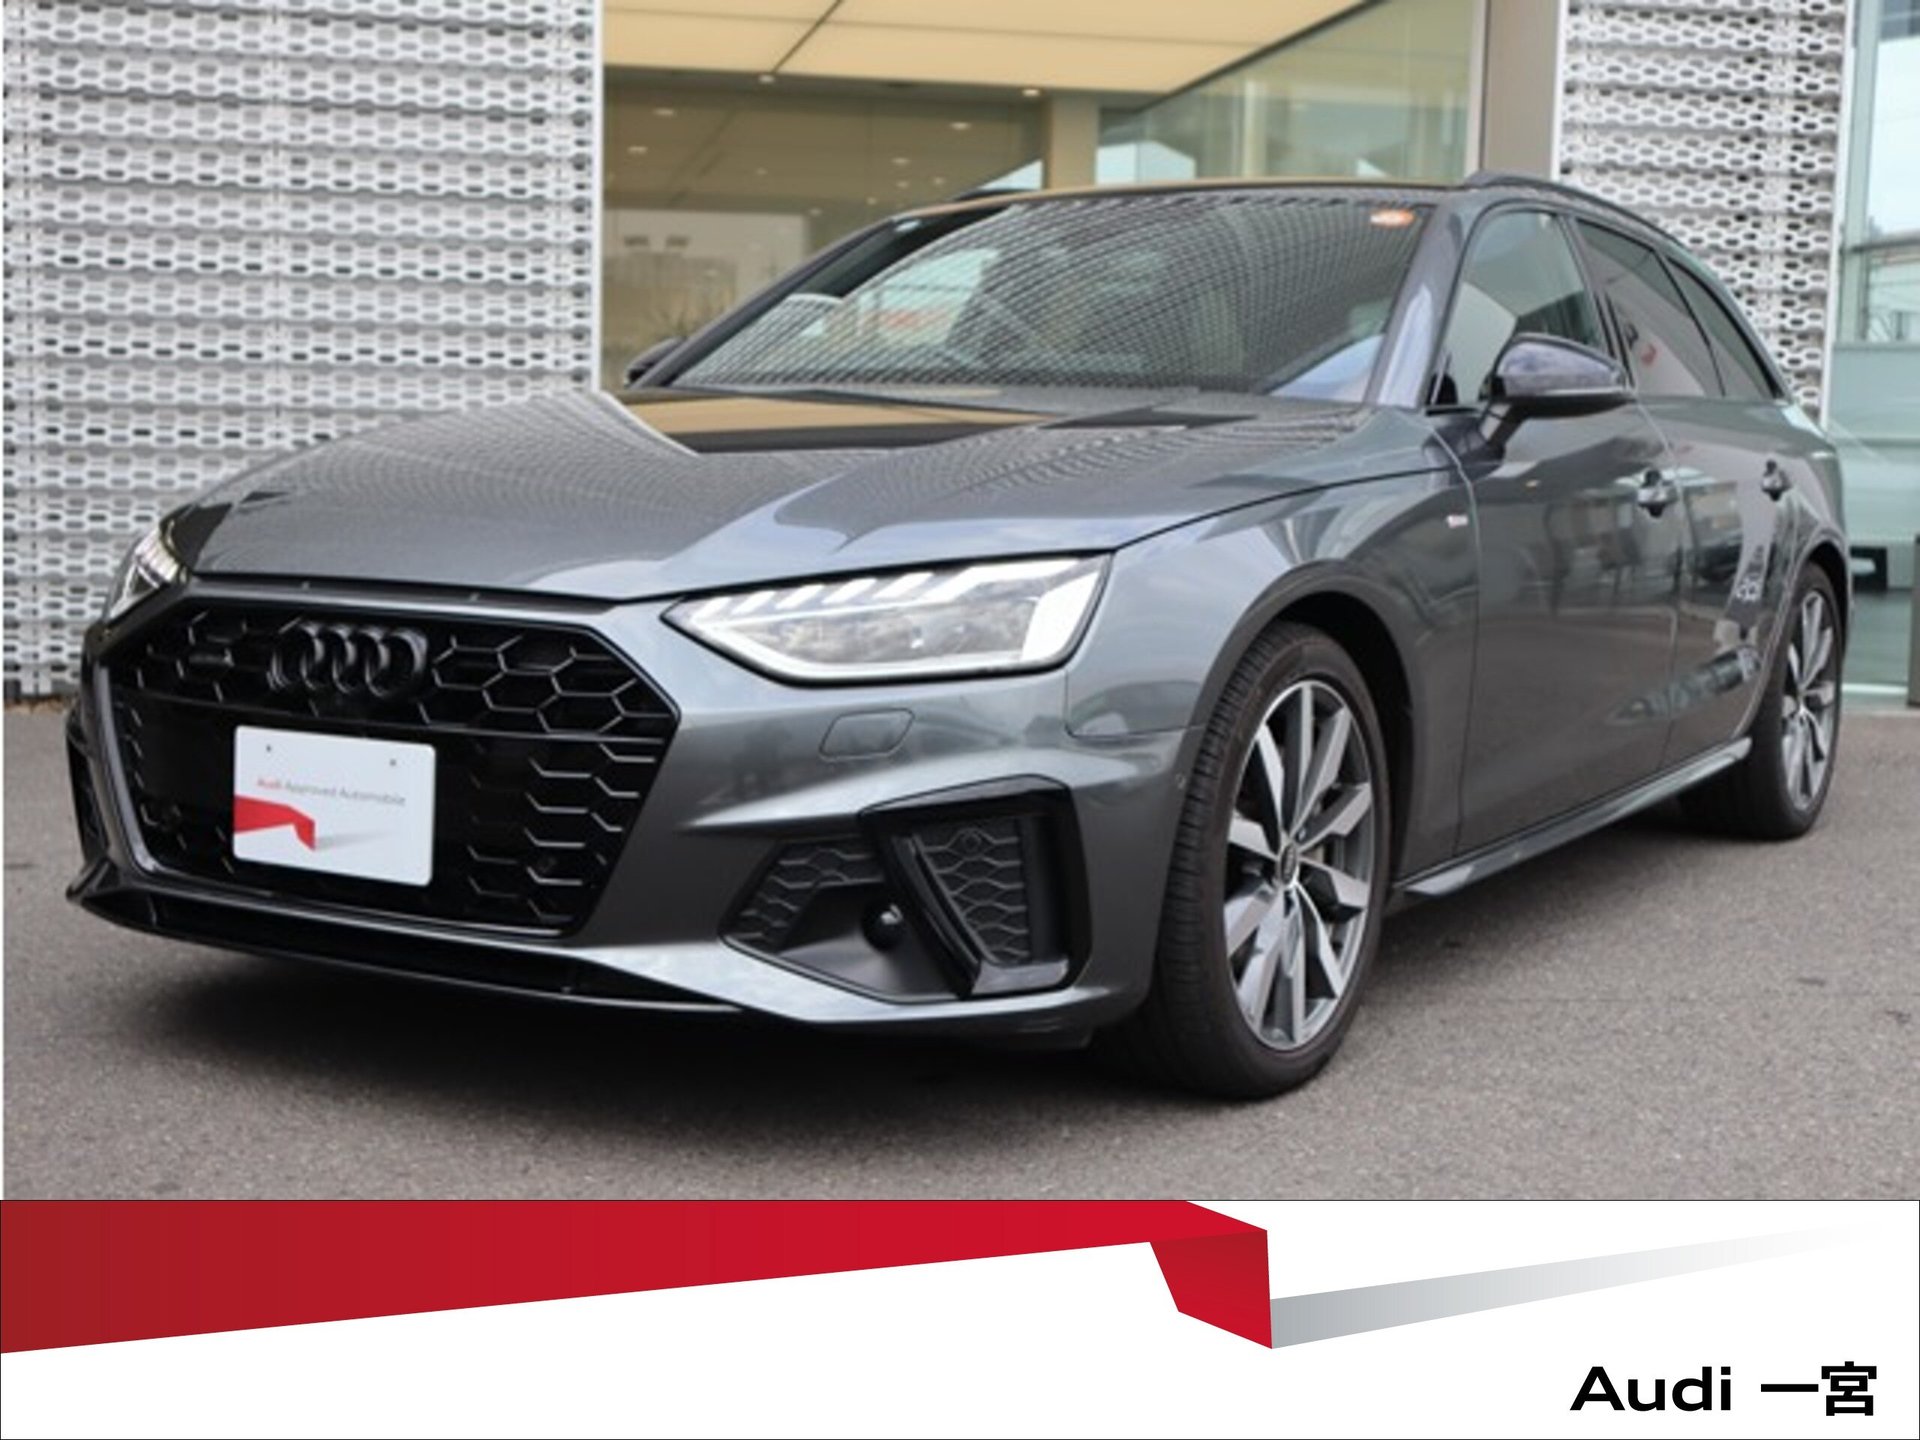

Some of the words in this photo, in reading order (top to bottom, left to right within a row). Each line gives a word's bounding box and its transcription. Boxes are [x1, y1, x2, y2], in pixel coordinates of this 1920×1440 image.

[257, 778, 282, 790] Audi
[285, 780, 337, 796] Approved
[340, 787, 406, 806] Automobile
